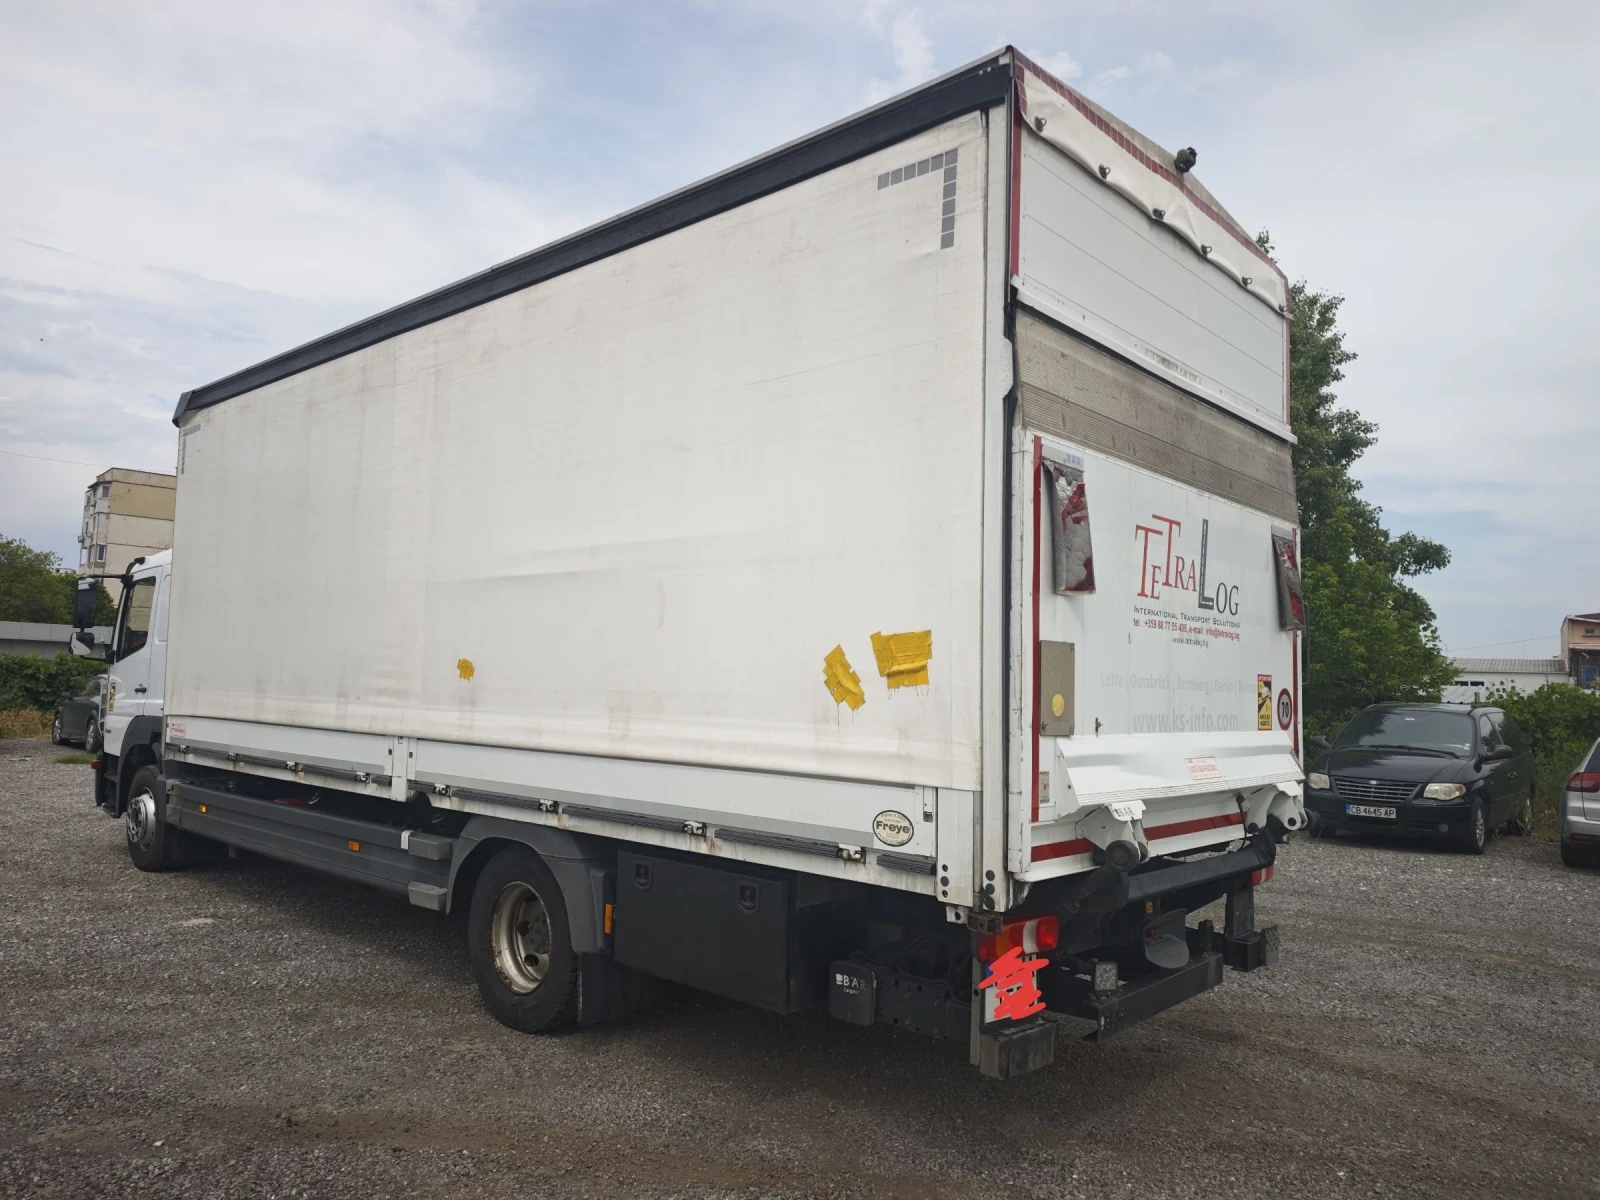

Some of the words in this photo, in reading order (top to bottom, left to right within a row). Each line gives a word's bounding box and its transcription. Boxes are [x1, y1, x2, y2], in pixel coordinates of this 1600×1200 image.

[1133, 604, 1179, 620] INTERNATIONAL
[1180, 612, 1211, 625] TRANSPORT
[1212, 617, 1241, 629] SOLUTIONS
[1164, 621, 1171, 631] 77
[1171, 621, 1178, 632] 55
[1100, 673, 1124, 688] Lotte
[1131, 673, 1172, 690] Osnabrück
[1177, 676, 1209, 695] Bernburg
[1214, 678, 1234, 694] Berlin
[1133, 706, 1239, 732] www.ks-info.com
[1281, 701, 1290, 719] 70
[1351, 806, 1361, 815] CB
[1363, 807, 1382, 816] 4645
[1384, 809, 1395, 817] AP
[875, 820, 911, 835] Freye
